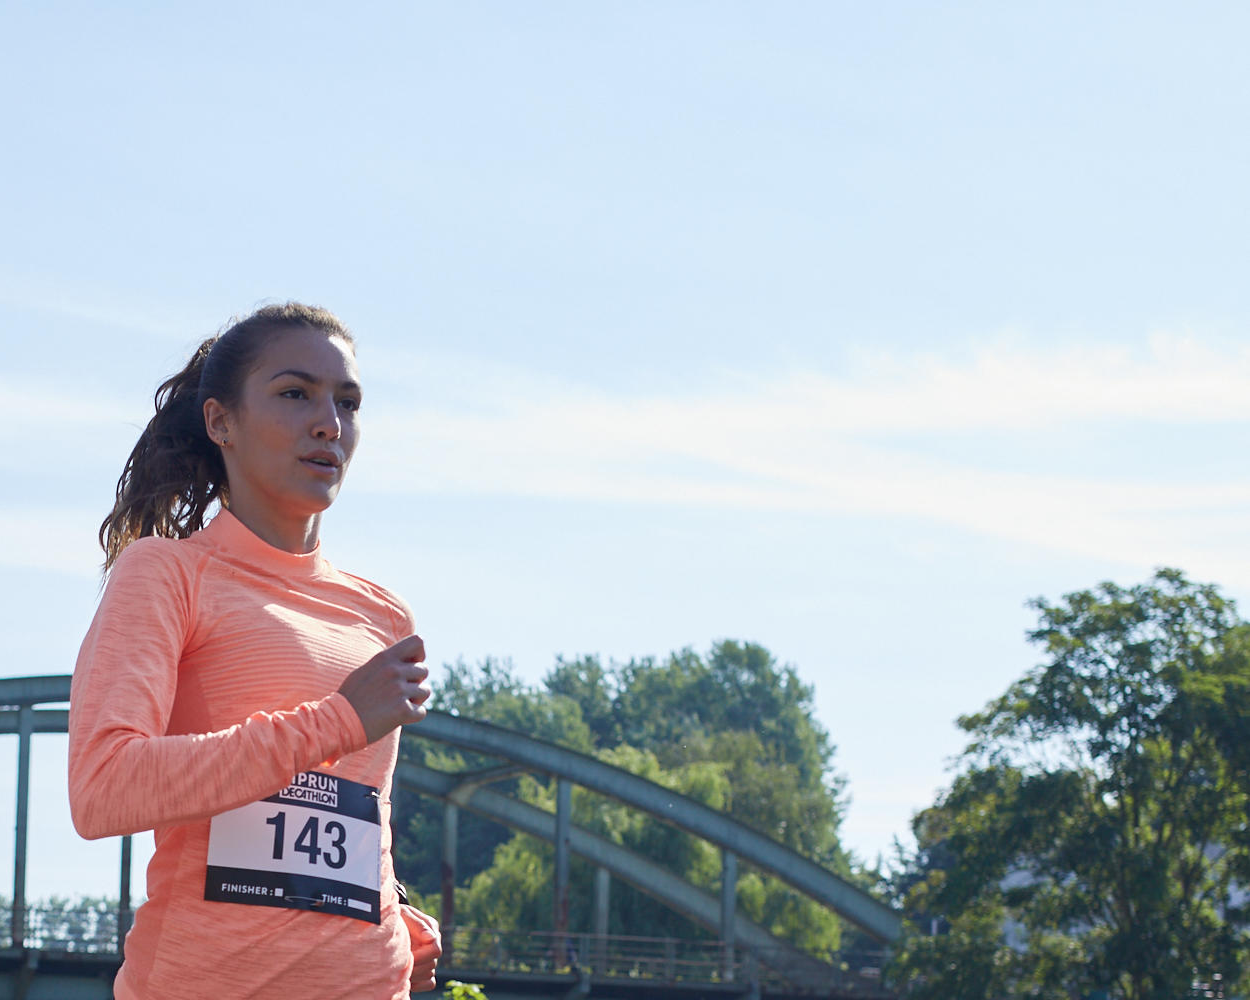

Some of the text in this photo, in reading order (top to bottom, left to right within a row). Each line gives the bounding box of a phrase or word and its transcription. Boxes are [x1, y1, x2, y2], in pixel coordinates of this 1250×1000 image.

[291, 772, 338, 793] IPRUN
[281, 787, 336, 806] DECATHLON
[265, 811, 347, 869] 143
[221, 883, 268, 896] FINISHER
